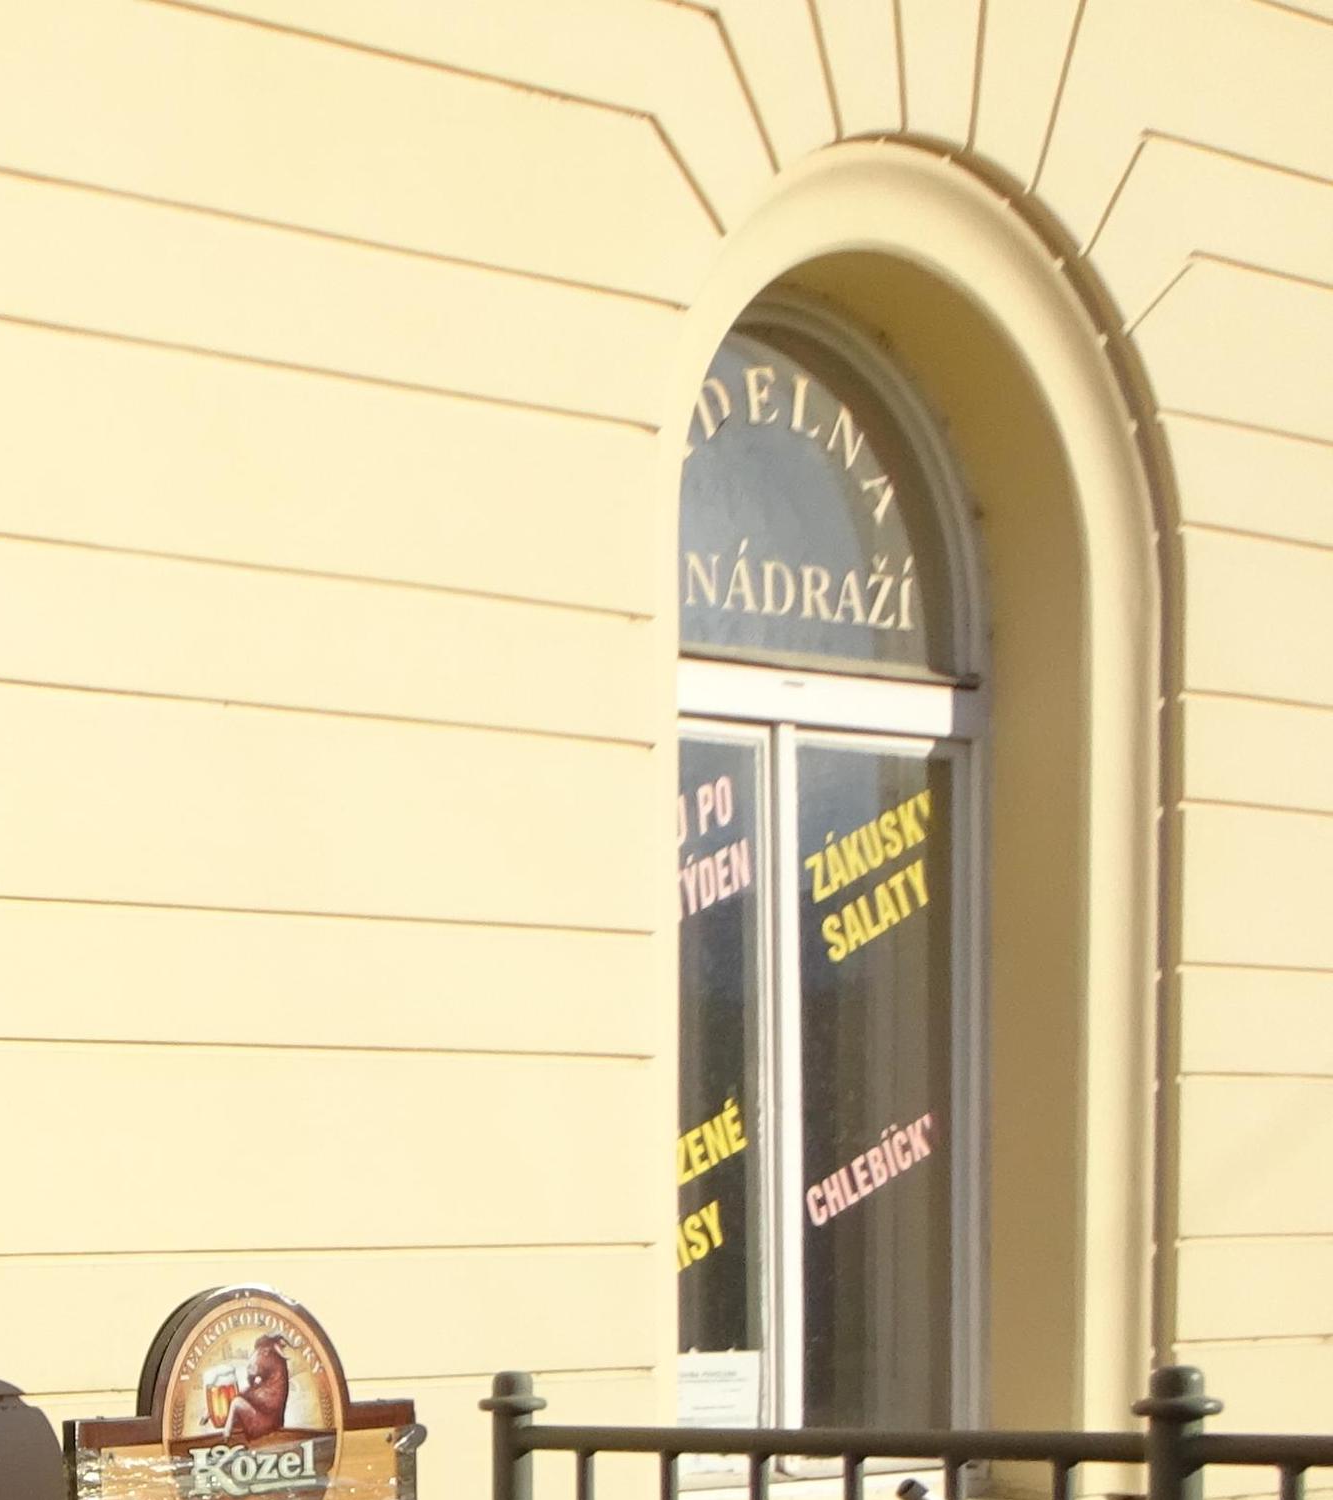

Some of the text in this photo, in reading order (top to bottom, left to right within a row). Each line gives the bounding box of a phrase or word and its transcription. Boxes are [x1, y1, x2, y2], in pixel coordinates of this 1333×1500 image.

[684, 366, 895, 525] DELNA
[684, 537, 915, 632] NÁDRAŽÍ
[697, 775, 732, 837] PO
[822, 859, 929, 962] SALATY
[189, 1440, 316, 1495] Kozel
